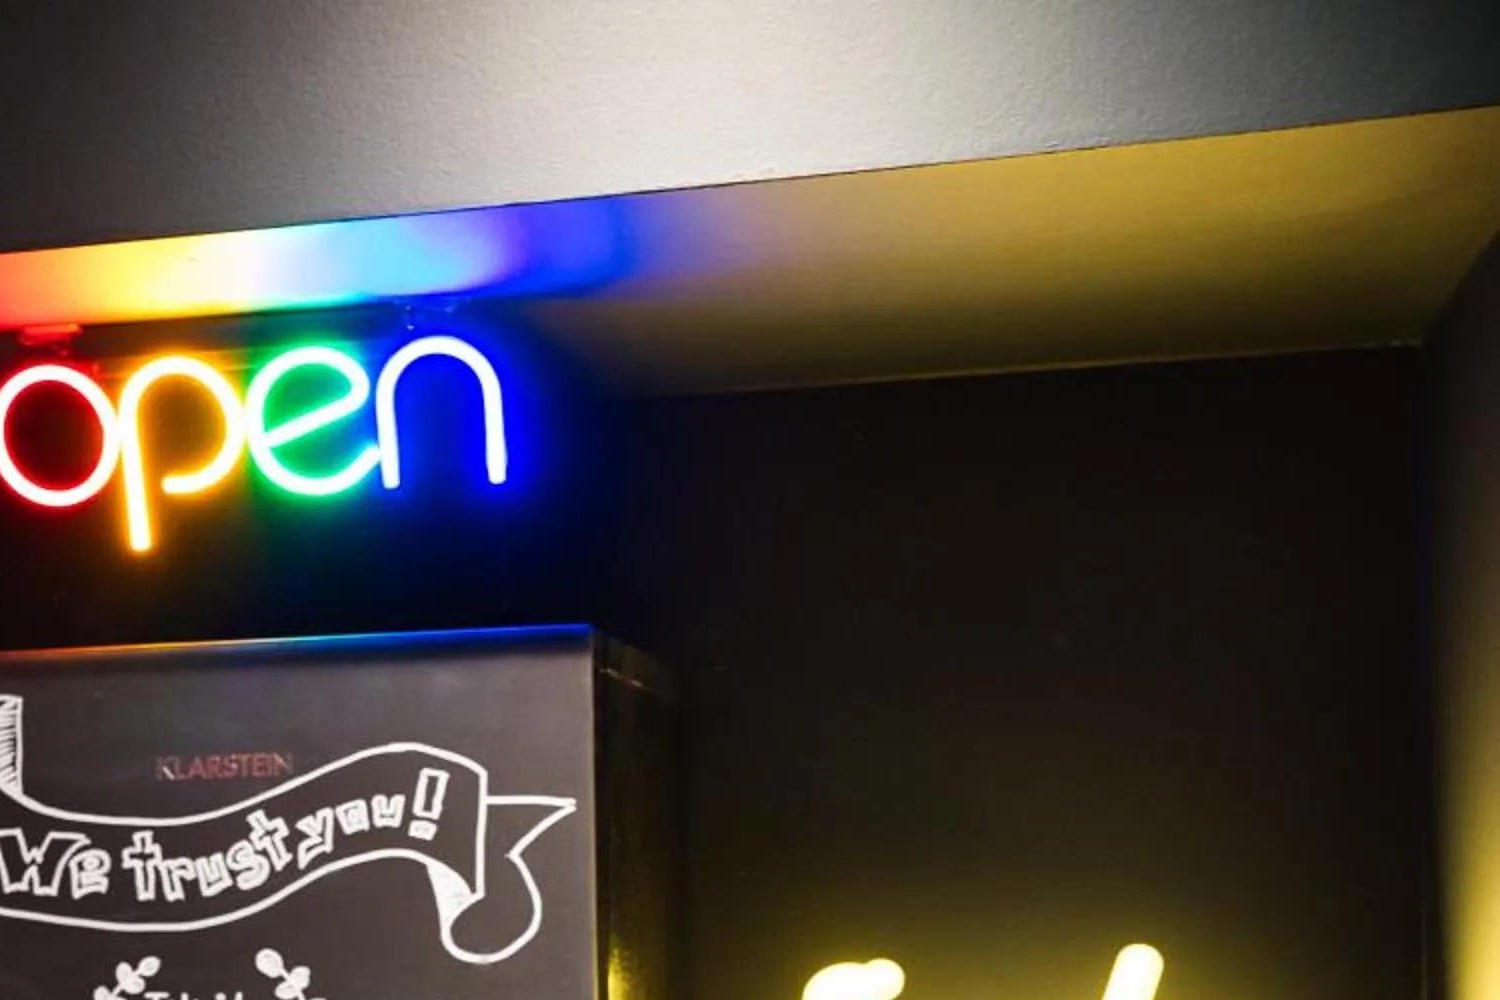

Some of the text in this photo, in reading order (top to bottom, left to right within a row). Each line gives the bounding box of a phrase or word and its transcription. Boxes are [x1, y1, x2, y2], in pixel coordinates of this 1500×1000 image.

[155, 752, 293, 782] KLARSTEIN
[122, 808, 296, 904] trust
[297, 768, 449, 869] you!
